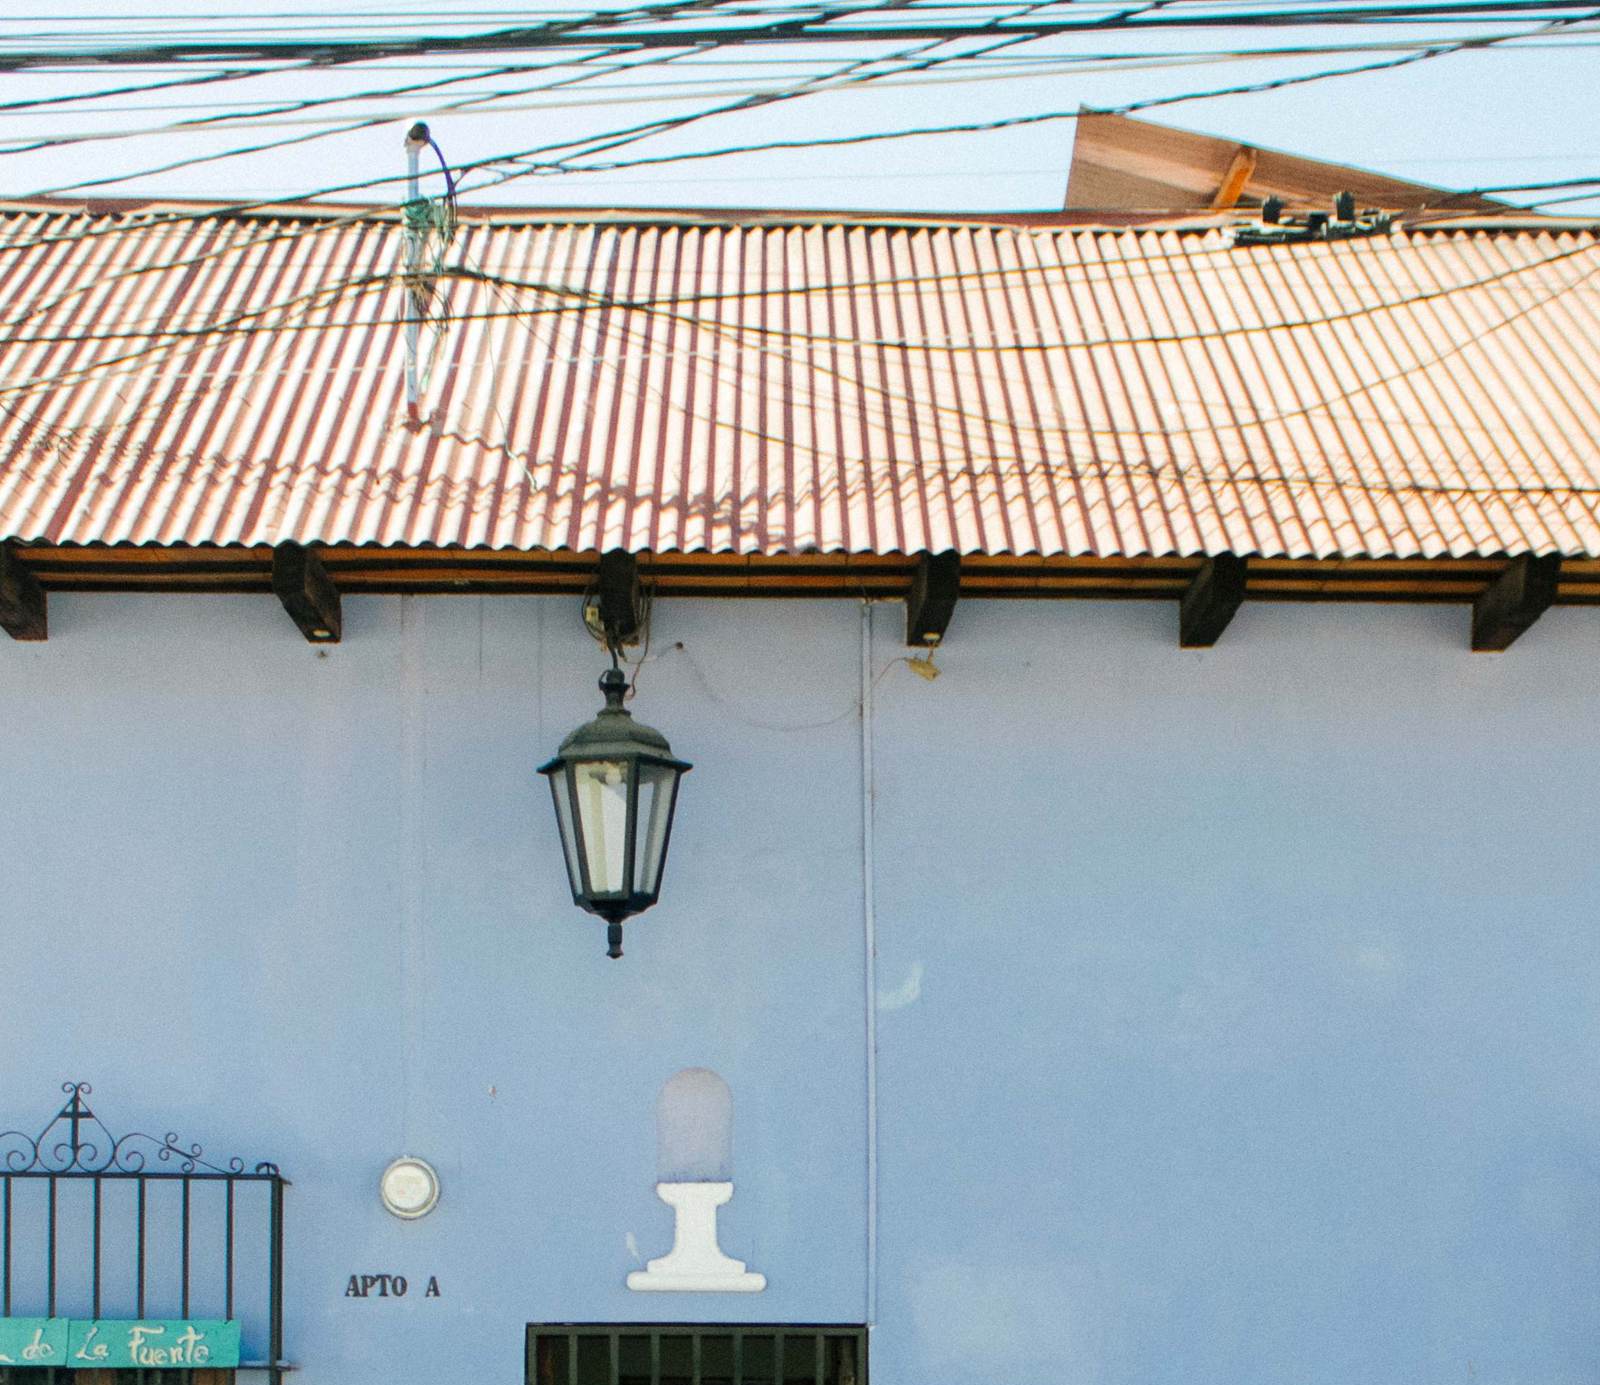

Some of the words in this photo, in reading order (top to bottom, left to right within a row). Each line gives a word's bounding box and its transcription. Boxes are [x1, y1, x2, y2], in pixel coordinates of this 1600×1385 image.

[345, 1274, 408, 1297] APTO
[426, 1276, 441, 1297] A
[22, 1328, 55, 1360] de
[75, 1327, 109, 1361] La
[128, 1326, 209, 1365] Fuente
